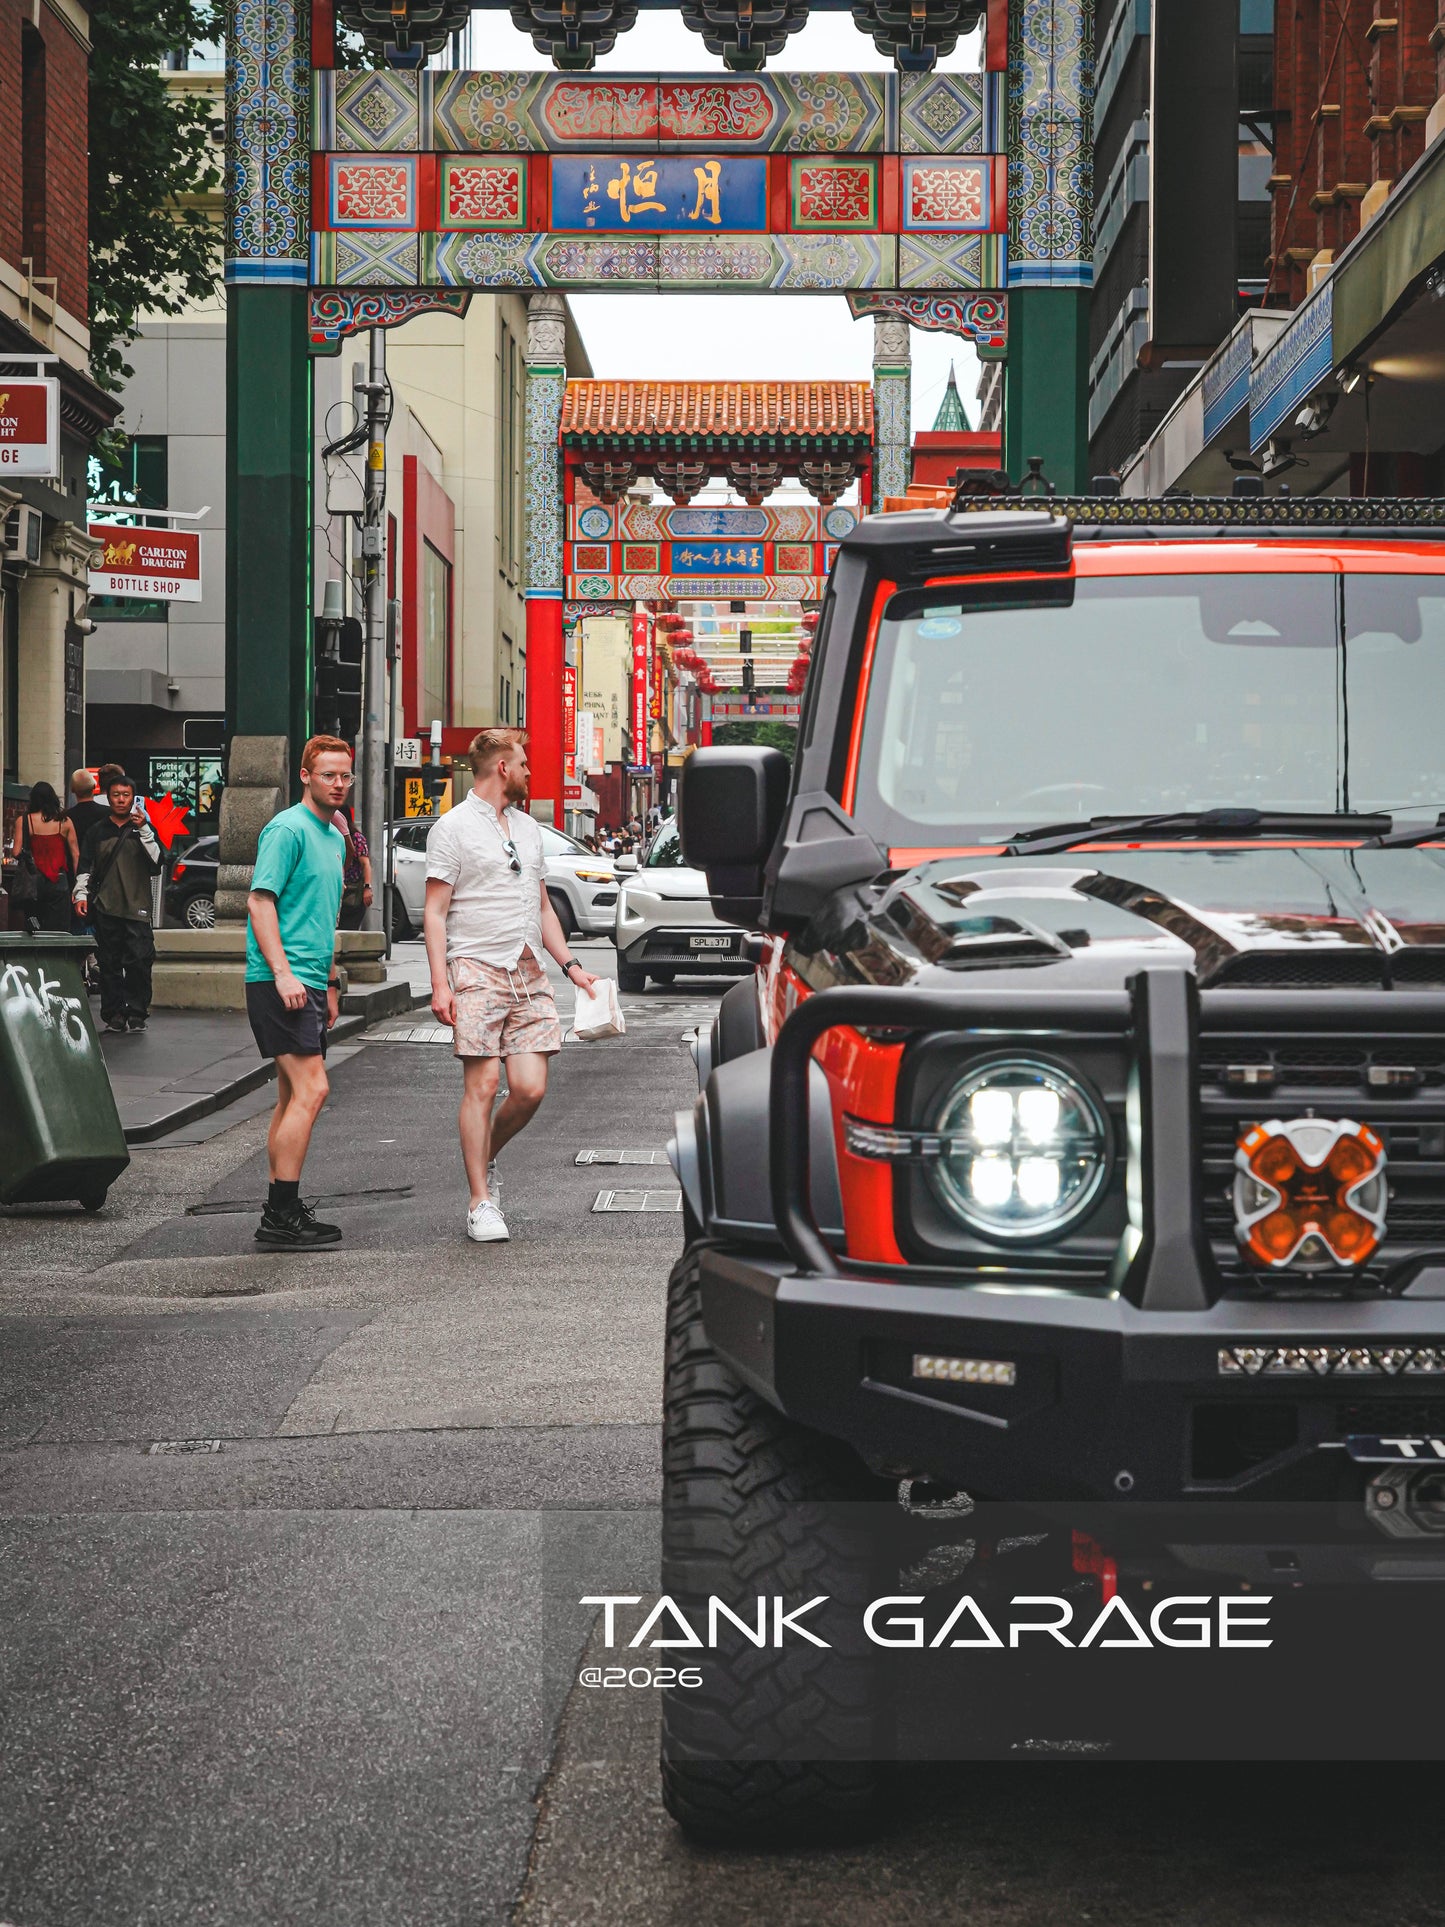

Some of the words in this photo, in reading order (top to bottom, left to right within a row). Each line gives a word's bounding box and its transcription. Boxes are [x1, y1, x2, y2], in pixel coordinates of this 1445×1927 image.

[0, 417, 19, 427] ON
[139, 546, 187, 560] CARLTON
[141, 557, 186, 569] DRAUGHT
[110, 577, 149, 592] BOTTLE
[153, 580, 181, 594] SHOP
[636, 692, 644, 729] EMPRESS
[567, 707, 575, 744] SHANGHAI
[636, 729, 644, 741] OF
[636, 741, 644, 766] CHINA
[156, 762, 183, 770] Better
[694, 938, 709, 947] SPL
[715, 938, 728, 947] 371
